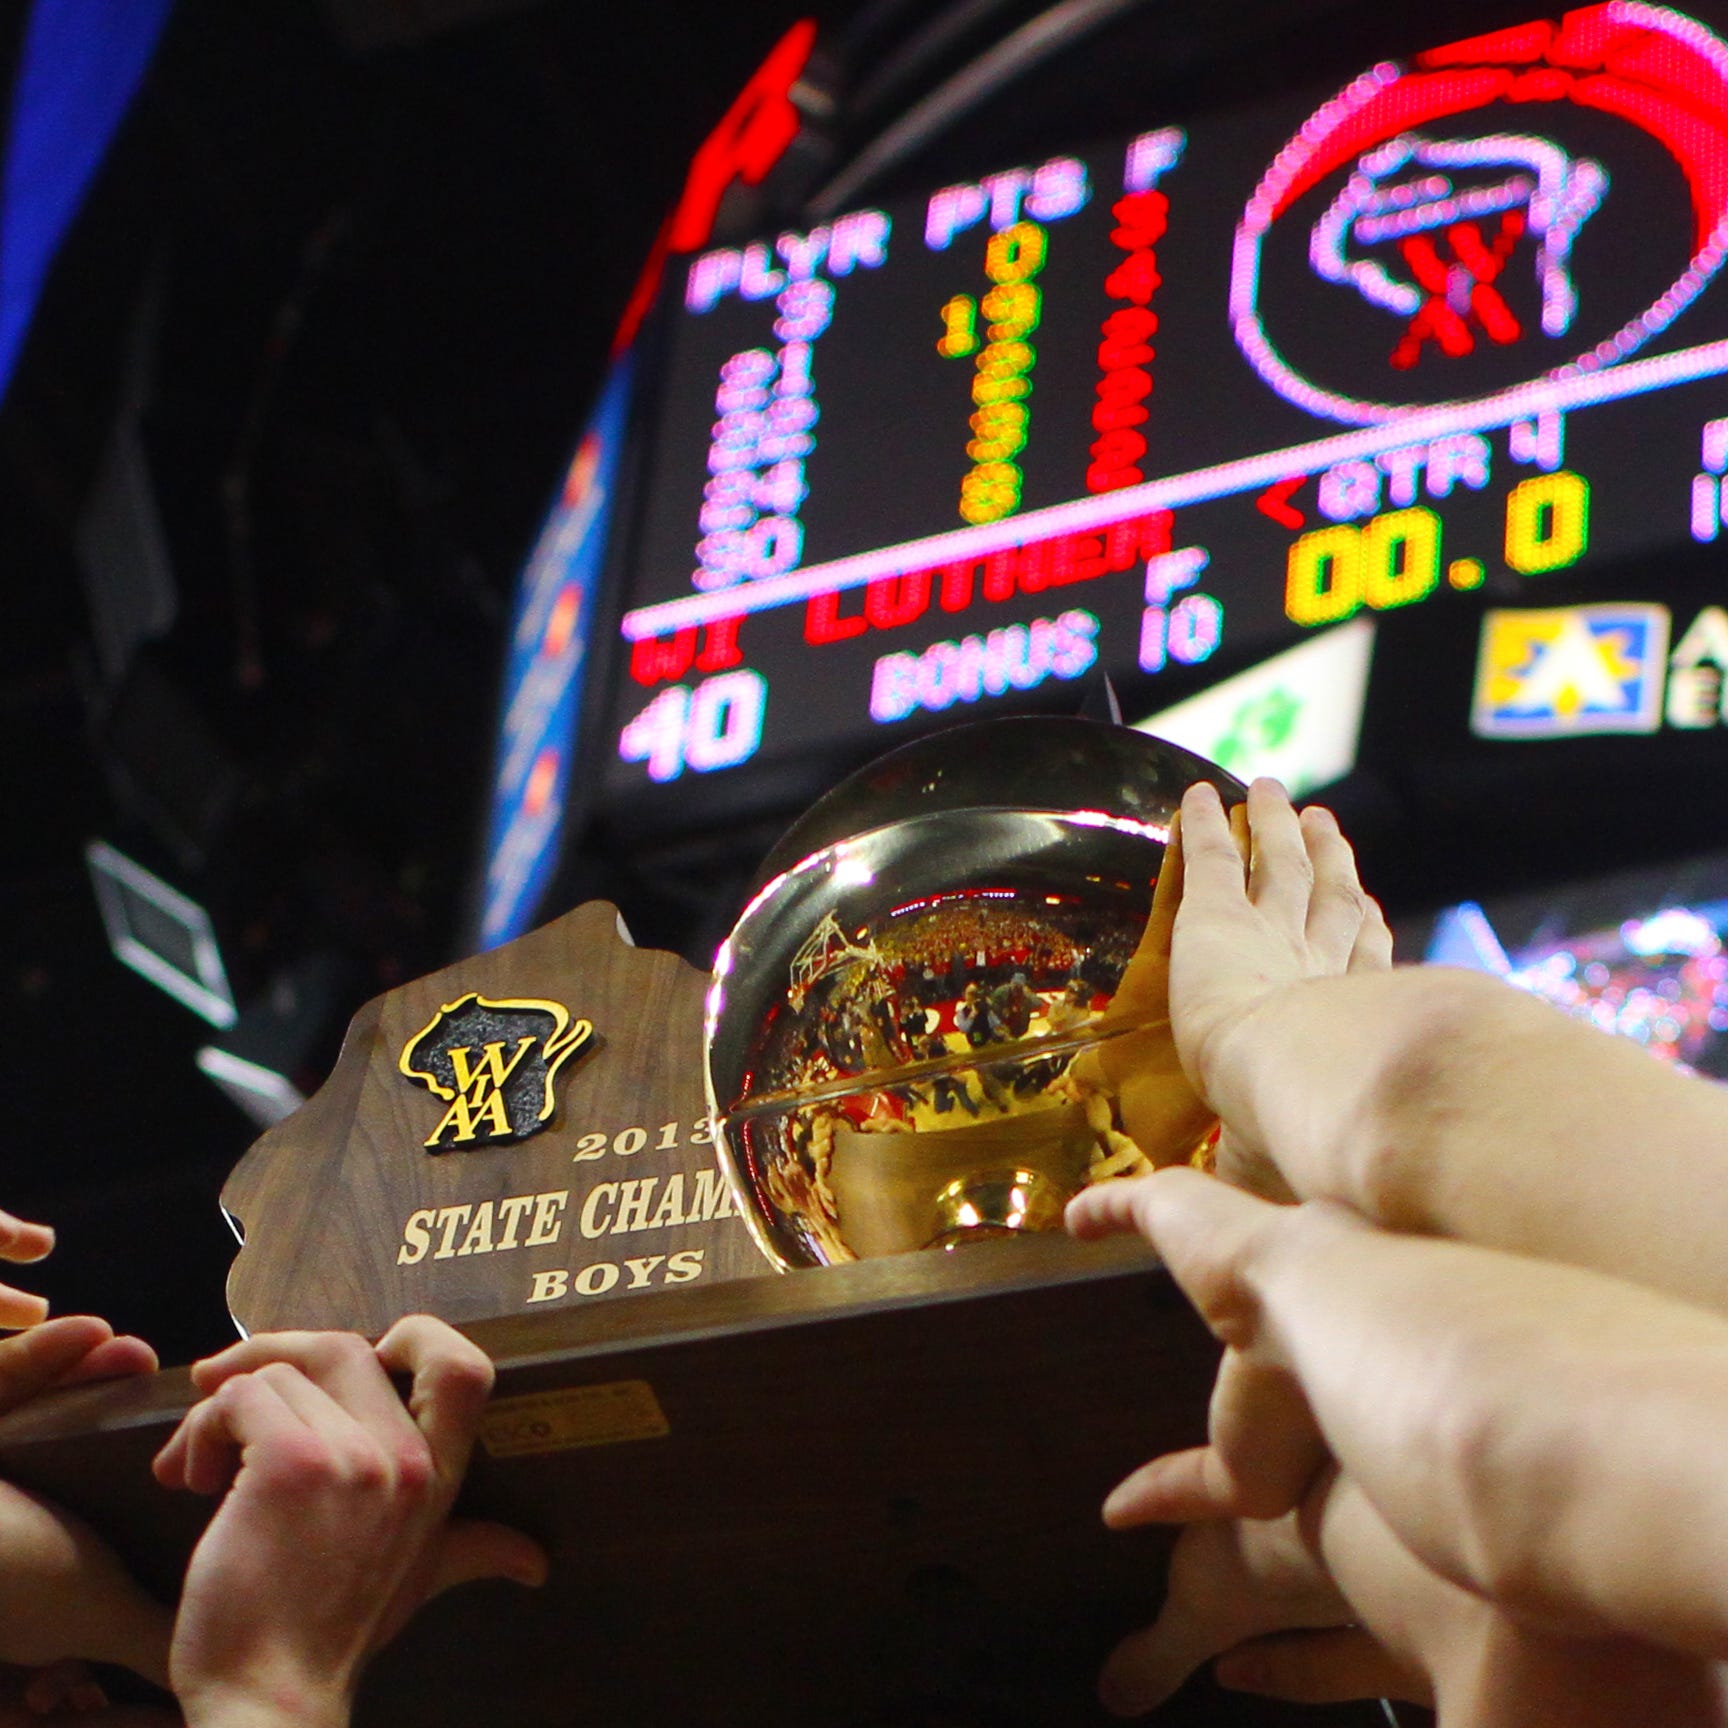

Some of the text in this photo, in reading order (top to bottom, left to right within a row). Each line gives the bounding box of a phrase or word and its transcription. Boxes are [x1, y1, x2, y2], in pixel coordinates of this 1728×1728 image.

[685, 125, 1187, 314] PLYR PTS F
[985, 221, 1048, 283] 0
[1318, 432, 1492, 520] QTR
[1144, 546, 1210, 607] F
[1285, 470, 1590, 628] 00.0
[618, 668, 768, 783] 40
[871, 608, 1100, 723] BONUS
[1138, 593, 1223, 674] 10
[572, 1117, 715, 1162] 2013
[396, 1190, 569, 1265] STATE
[526, 1249, 705, 1304] BOYS
